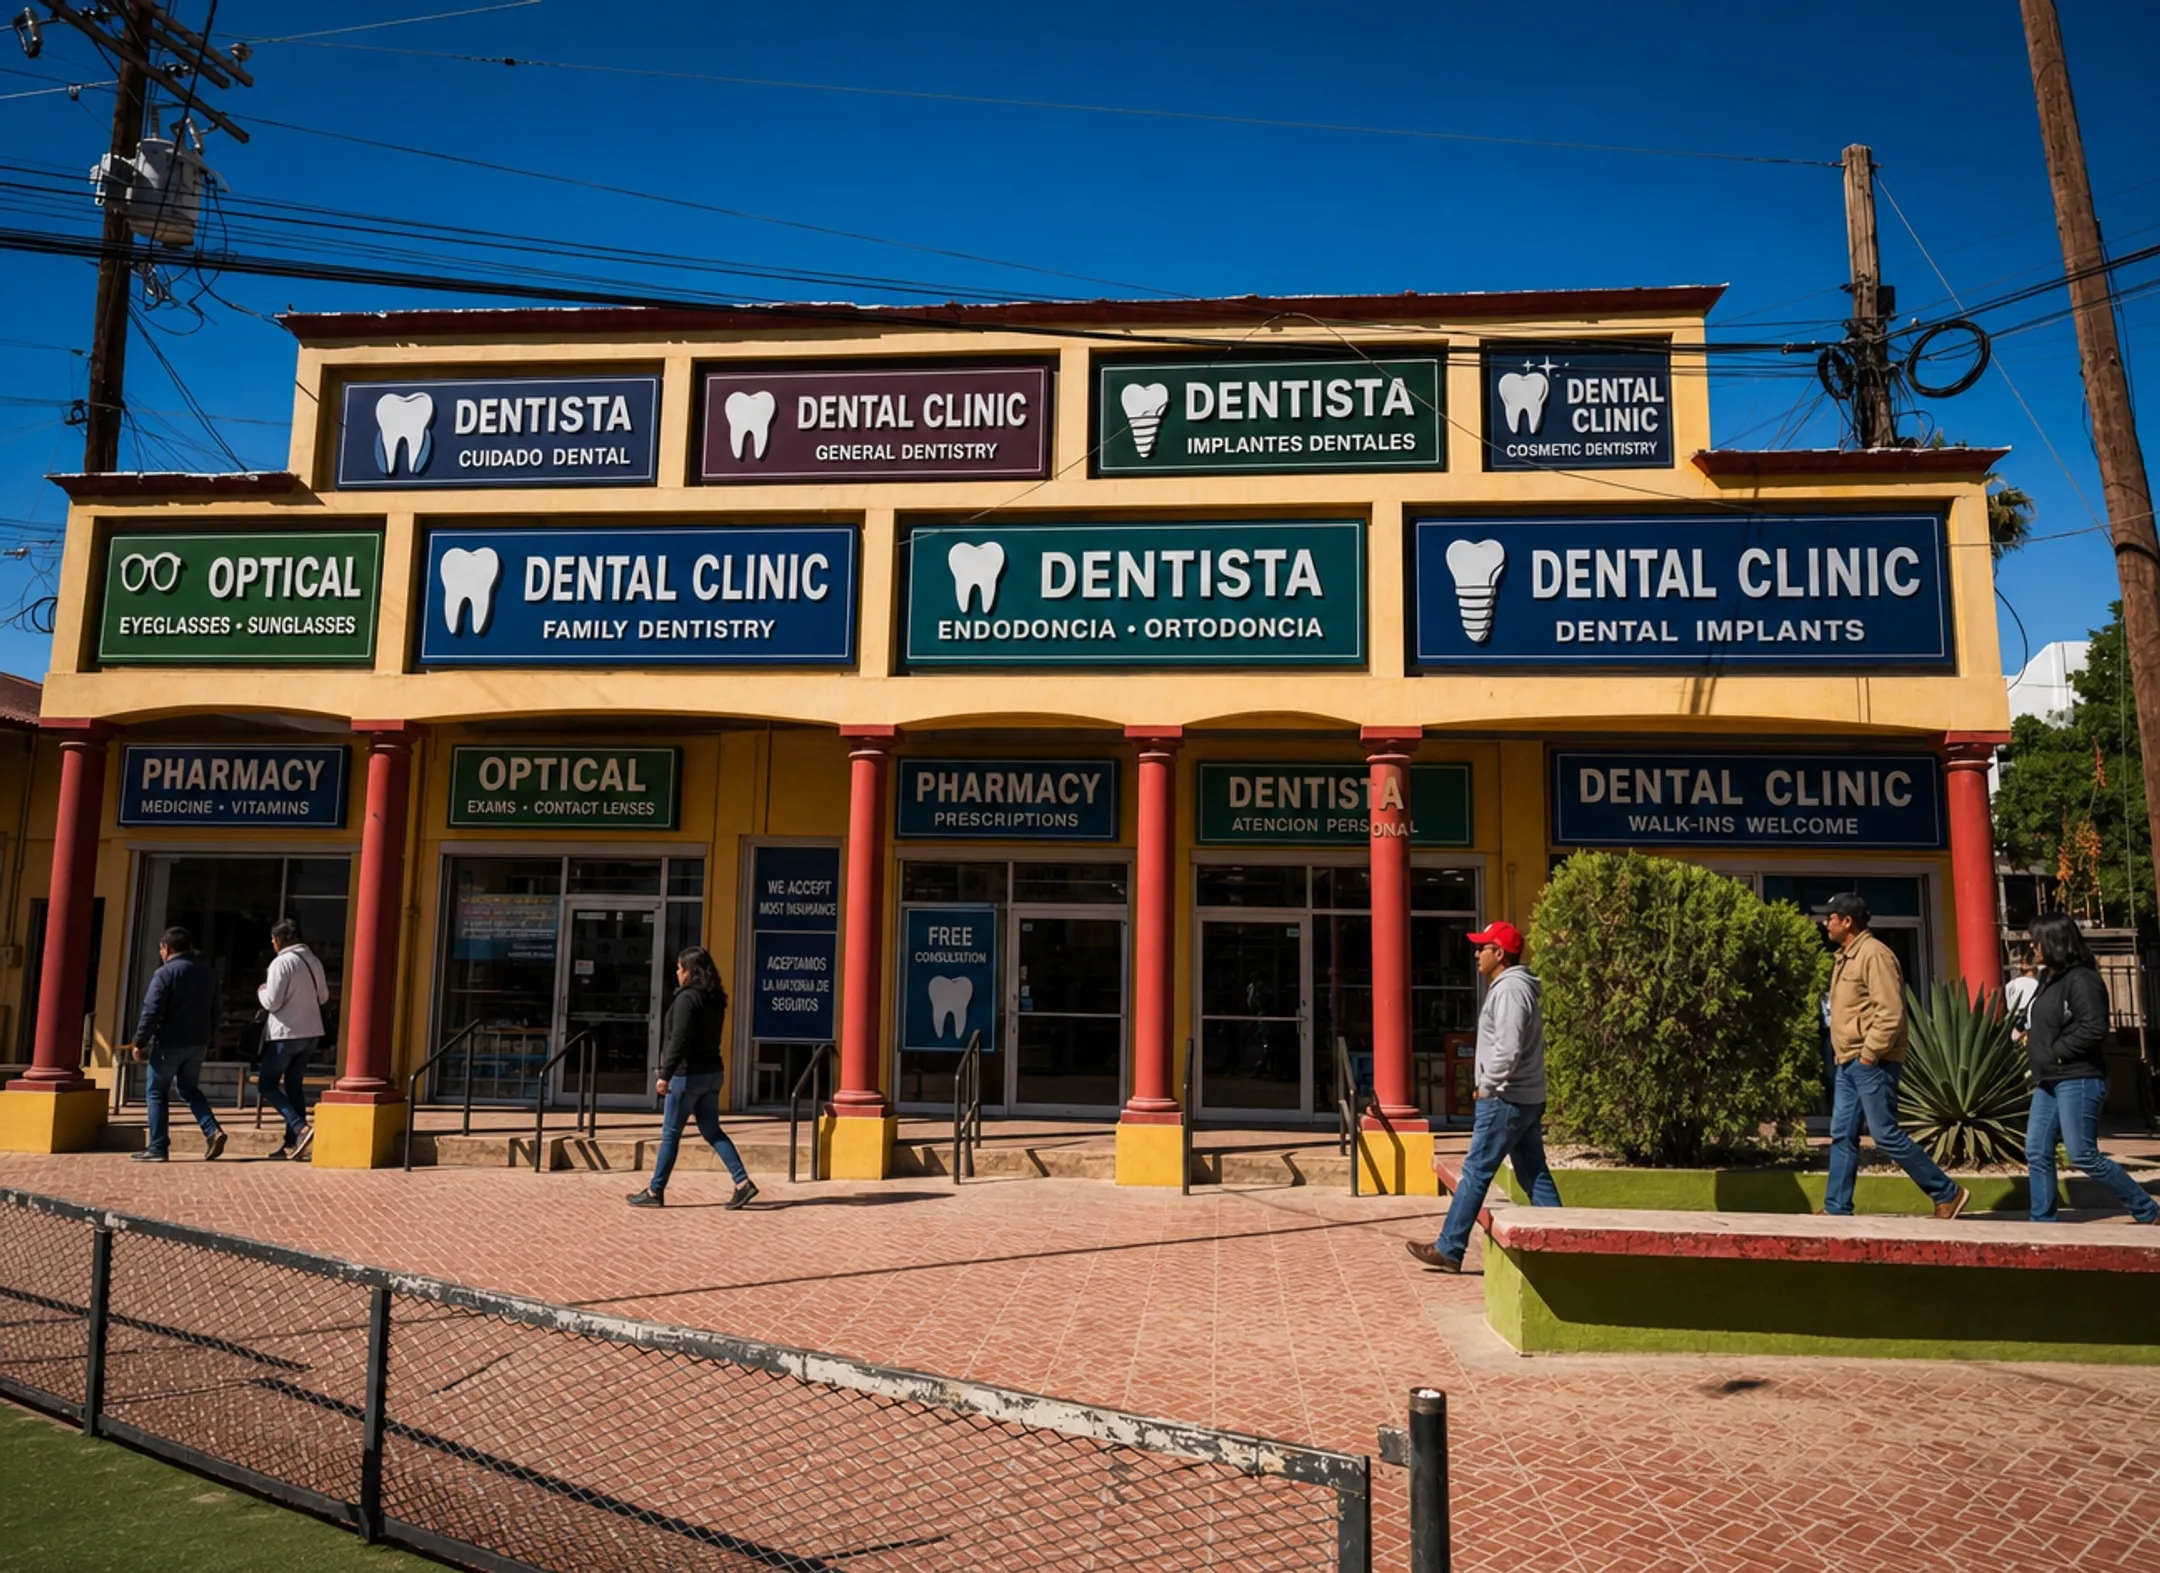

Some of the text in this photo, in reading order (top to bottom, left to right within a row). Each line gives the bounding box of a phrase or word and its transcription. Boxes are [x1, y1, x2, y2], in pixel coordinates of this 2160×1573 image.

[1186, 378, 1414, 420] DENTISTA
[1568, 377, 1664, 404] DENTAL
[455, 396, 631, 434] DENTISTA
[798, 392, 1026, 429] DENTAL CLINIC
[1572, 407, 1658, 432] CLINIC
[816, 443, 997, 460] GENERAL DENTISTRY
[1188, 433, 1415, 453] IMPLANTES DENTALES
[1507, 442, 1657, 457] COSMETIC DENTISTRY
[459, 447, 630, 467] CUIDADO DENTAL
[209, 556, 360, 597] OPTICAL
[525, 553, 828, 601] DENTAL CLINIC
[1041, 549, 1322, 598] DENTISTA
[1532, 547, 1920, 598] DENTAL CLINIC
[120, 616, 355, 634] EYEGLASSES SUNGLASSES
[544, 620, 774, 638] FAMILY DENTISTRY
[939, 617, 1322, 639] ENDODONCIA ORTODONCIA
[1557, 620, 1864, 641] DENTAL IMPLANTS
[142, 758, 324, 791] PHARMACY
[479, 757, 646, 791] OPTICAL
[917, 772, 1101, 804] PHARMACY
[1230, 777, 1404, 810] DENTISTA
[1580, 768, 1912, 807] DENTAL CLINIC
[142, 800, 309, 814] MEDICINE VITAMINS
[468, 800, 654, 815] EXAMS CONTACT LENSES
[935, 812, 1078, 827] PRESCRIPTIONS
[1232, 818, 1419, 837] ATENCION PERSONAL
[1629, 815, 1858, 834] WALK-INS WELCOME
[768, 880, 832, 895] WE ACCEPT
[929, 927, 972, 946] FREE
[763, 979, 774, 991] LA
[816, 980, 829, 992] DE
